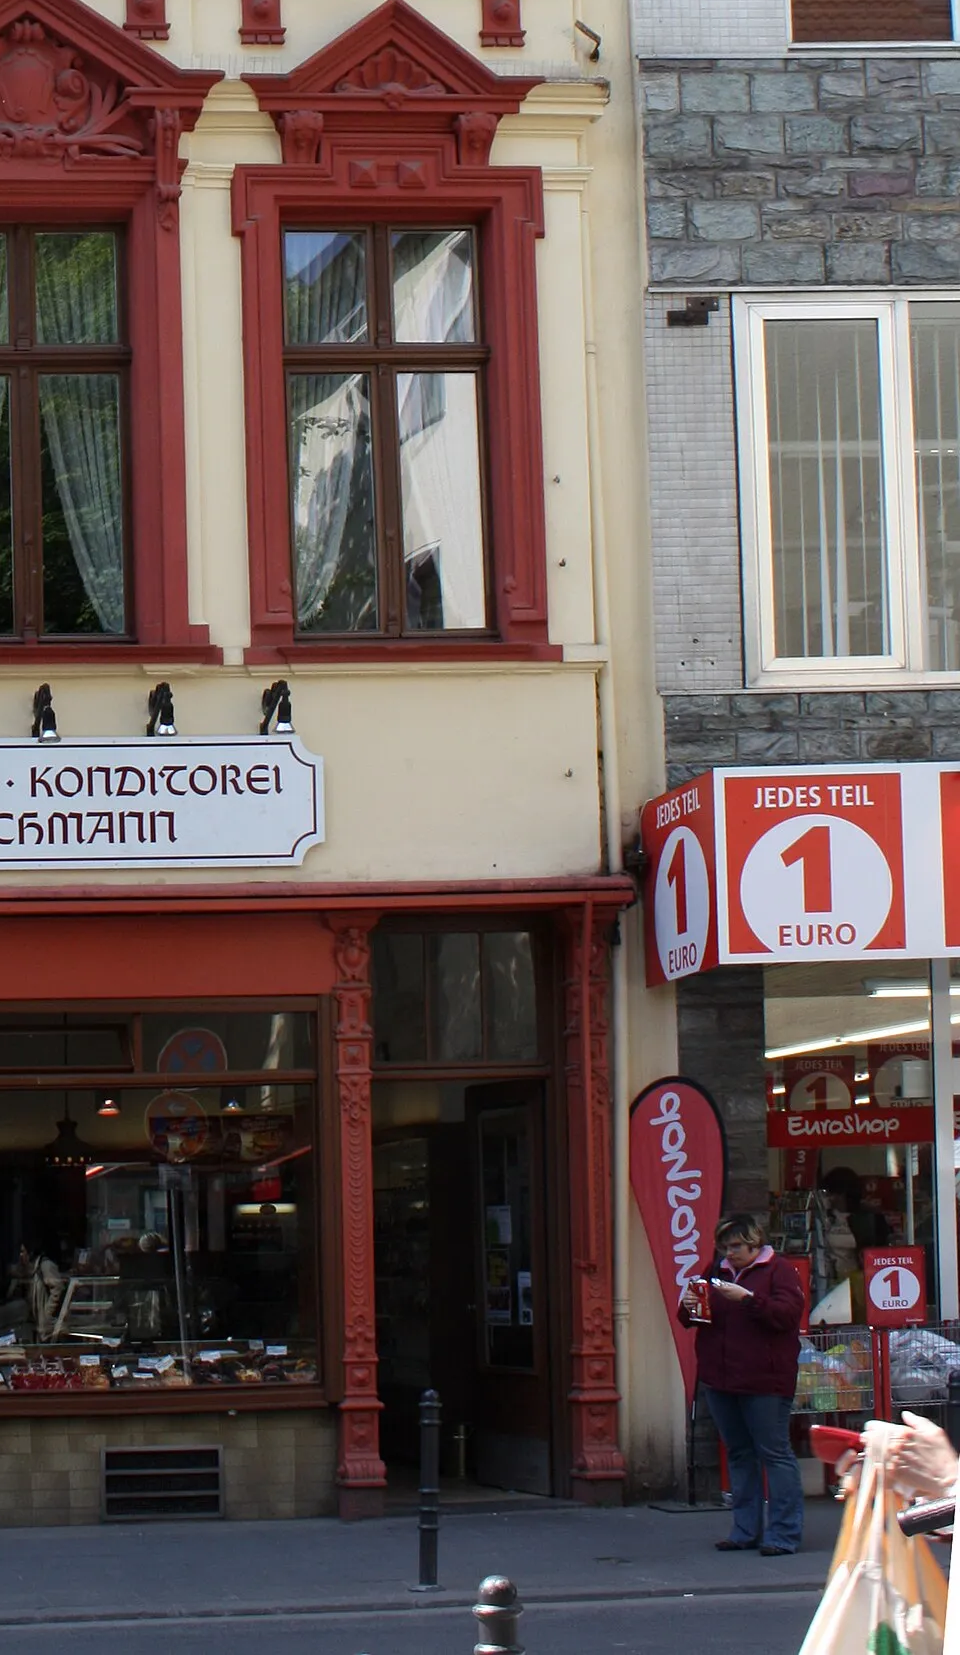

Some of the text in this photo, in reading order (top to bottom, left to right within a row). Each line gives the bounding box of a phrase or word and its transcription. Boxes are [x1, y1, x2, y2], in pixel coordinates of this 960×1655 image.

[30, 764, 283, 797] KONDITOREI
[656, 787, 701, 829] JEDES TEIL
[754, 785, 875, 809] JEDES TEIL
[780, 825, 833, 913] 1
[667, 837, 688, 935] 1
[779, 923, 857, 947] EURO
[668, 942, 698, 974] EURO
[787, 1113, 901, 1138] EuroShop
[795, 1149, 807, 1164] 3
[873, 1256, 914, 1266] JEDES TEIL
[882, 1269, 901, 1297] 1
[882, 1299, 909, 1308] EURO
